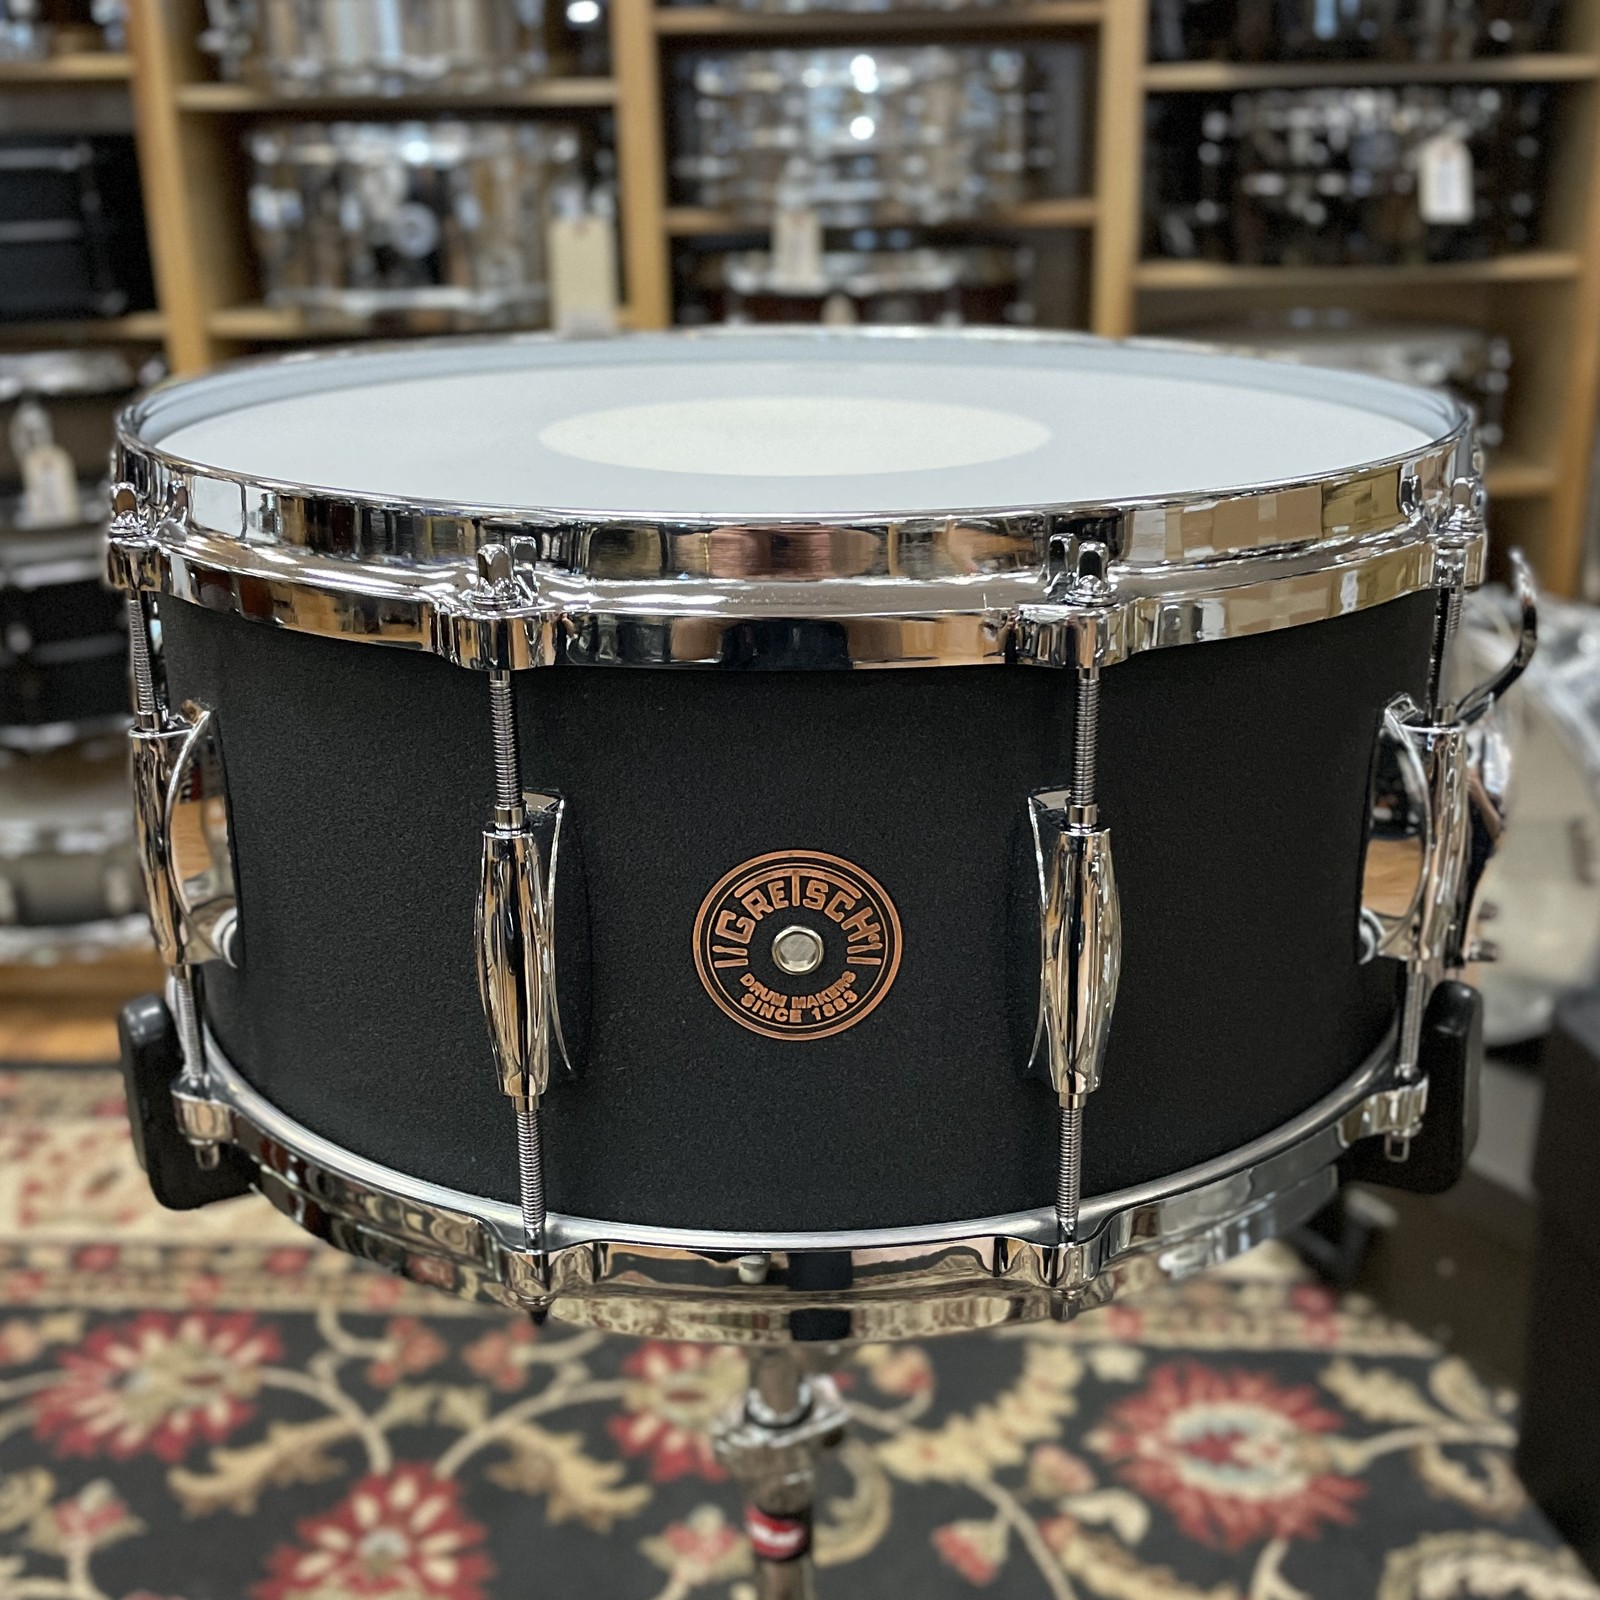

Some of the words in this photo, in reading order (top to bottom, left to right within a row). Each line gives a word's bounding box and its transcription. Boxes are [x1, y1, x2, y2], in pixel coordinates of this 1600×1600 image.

[715, 868, 881, 944] GRETSCH
[740, 973, 788, 1008] DRUM
[791, 971, 856, 1009] MAKERS
[741, 993, 802, 1023] SINCE
[811, 990, 858, 1021] 1883
